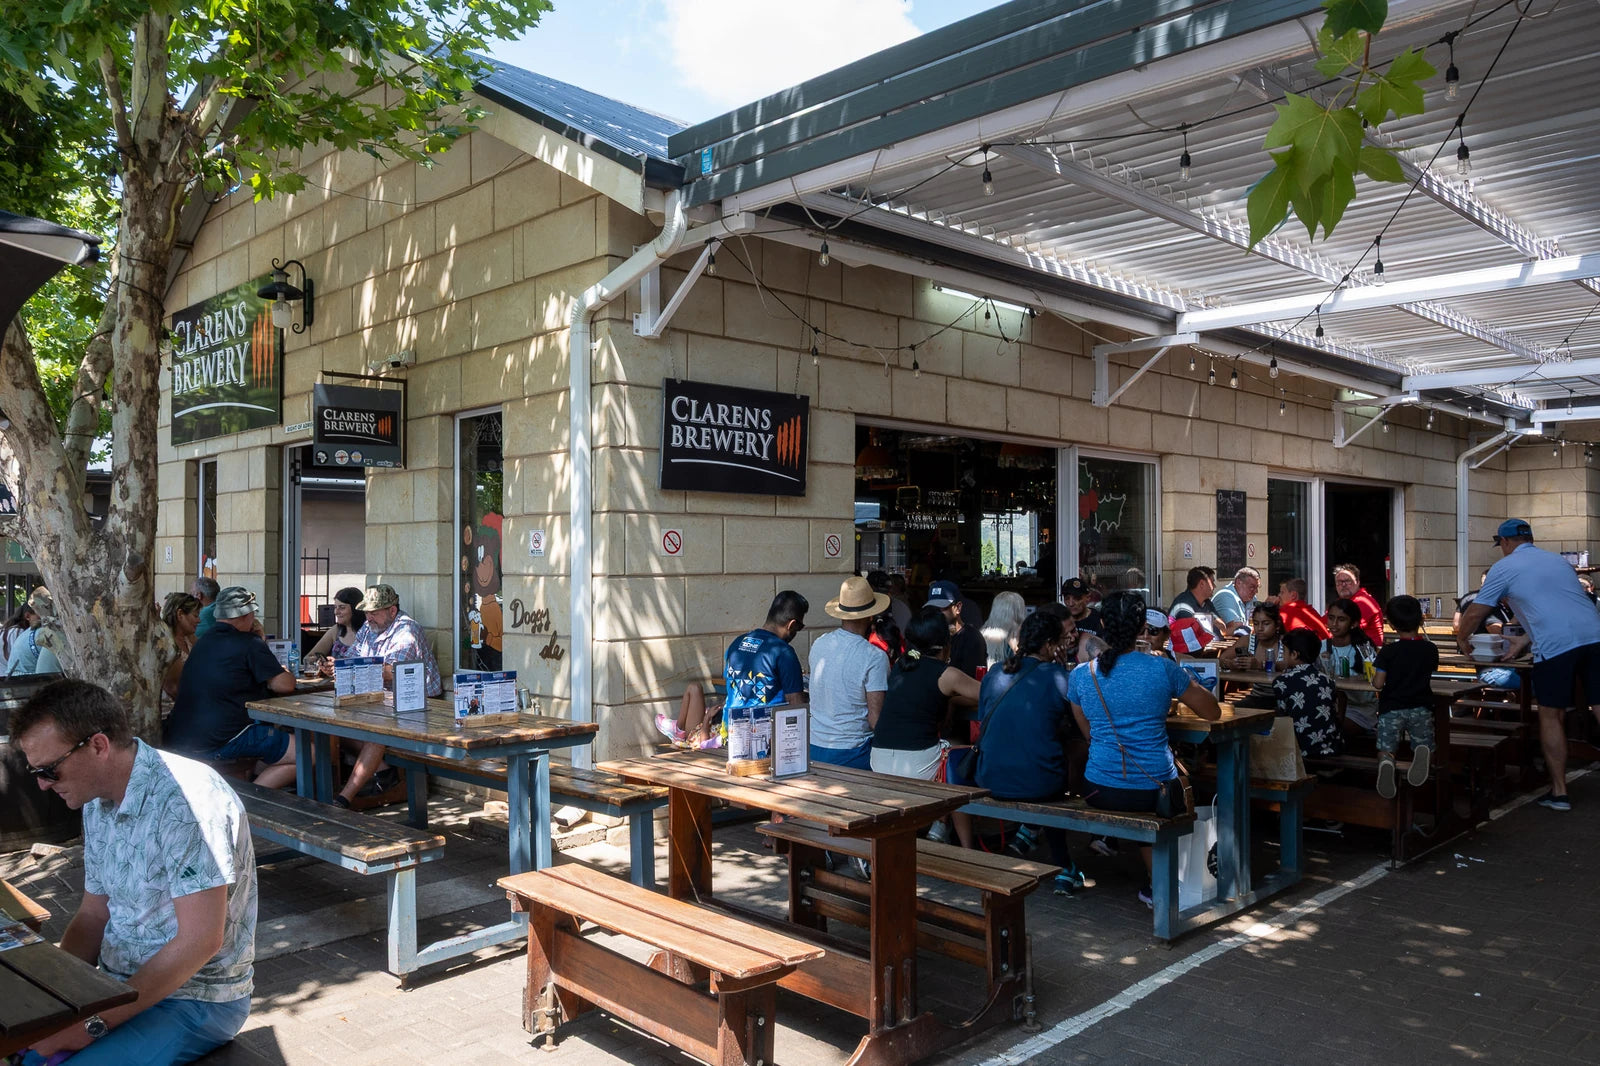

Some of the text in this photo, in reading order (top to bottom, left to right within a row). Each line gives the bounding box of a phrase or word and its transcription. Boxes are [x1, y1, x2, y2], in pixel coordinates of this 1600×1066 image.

[174, 301, 247, 358] CLARENS
[174, 341, 250, 396] BREWERY
[323, 408, 375, 422] CLARENS
[324, 420, 377, 435] BREWERY
[671, 396, 772, 431] CLARENS
[671, 424, 775, 461] BREWERY
[509, 598, 551, 634] Doggy
